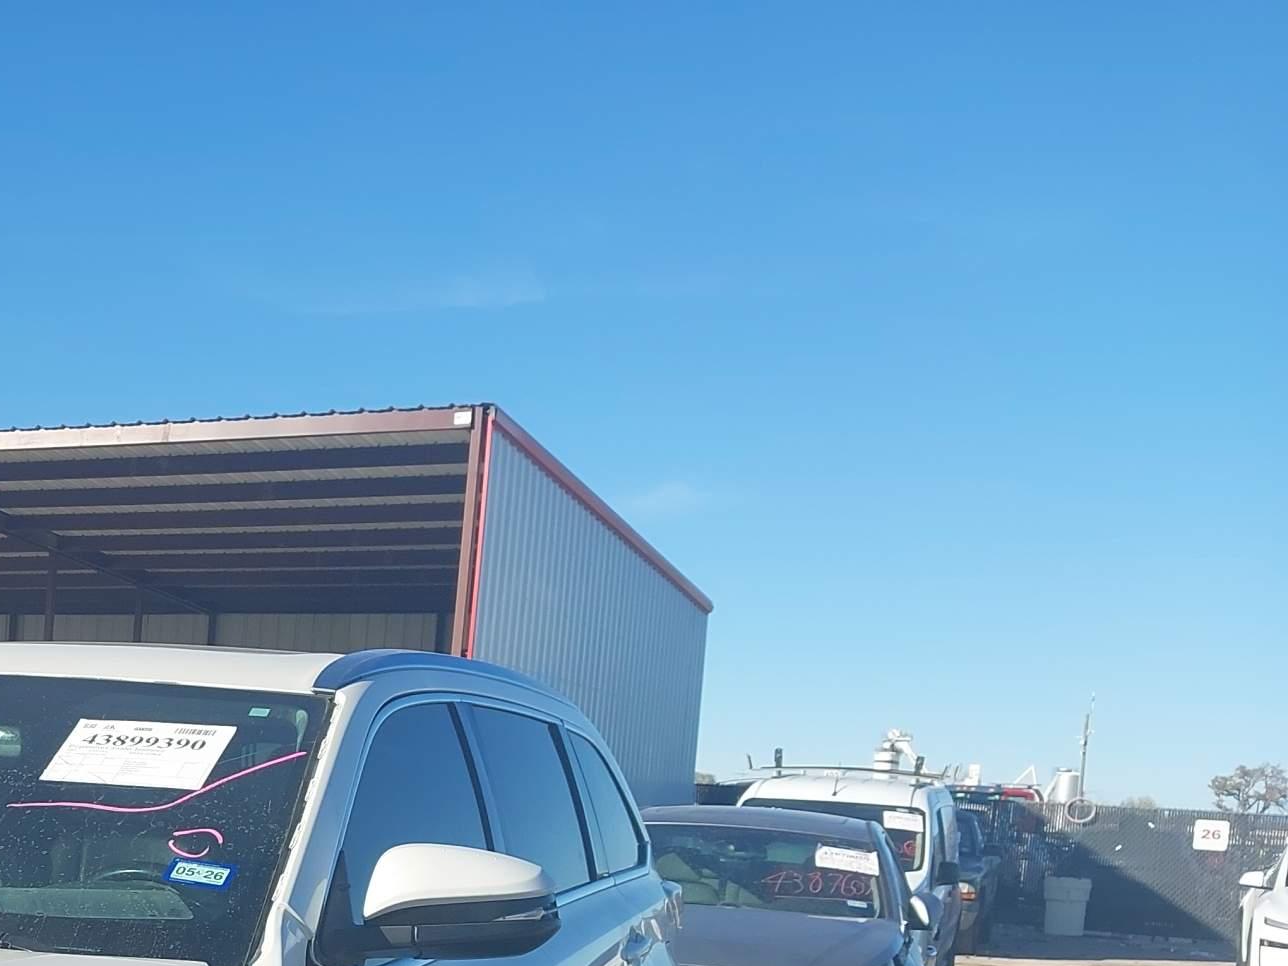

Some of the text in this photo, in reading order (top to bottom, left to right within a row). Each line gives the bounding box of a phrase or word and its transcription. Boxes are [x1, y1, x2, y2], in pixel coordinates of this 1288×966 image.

[82, 733, 207, 751] 43899390
[1200, 828, 1222, 840] 26
[175, 865, 225, 881] 05 26
